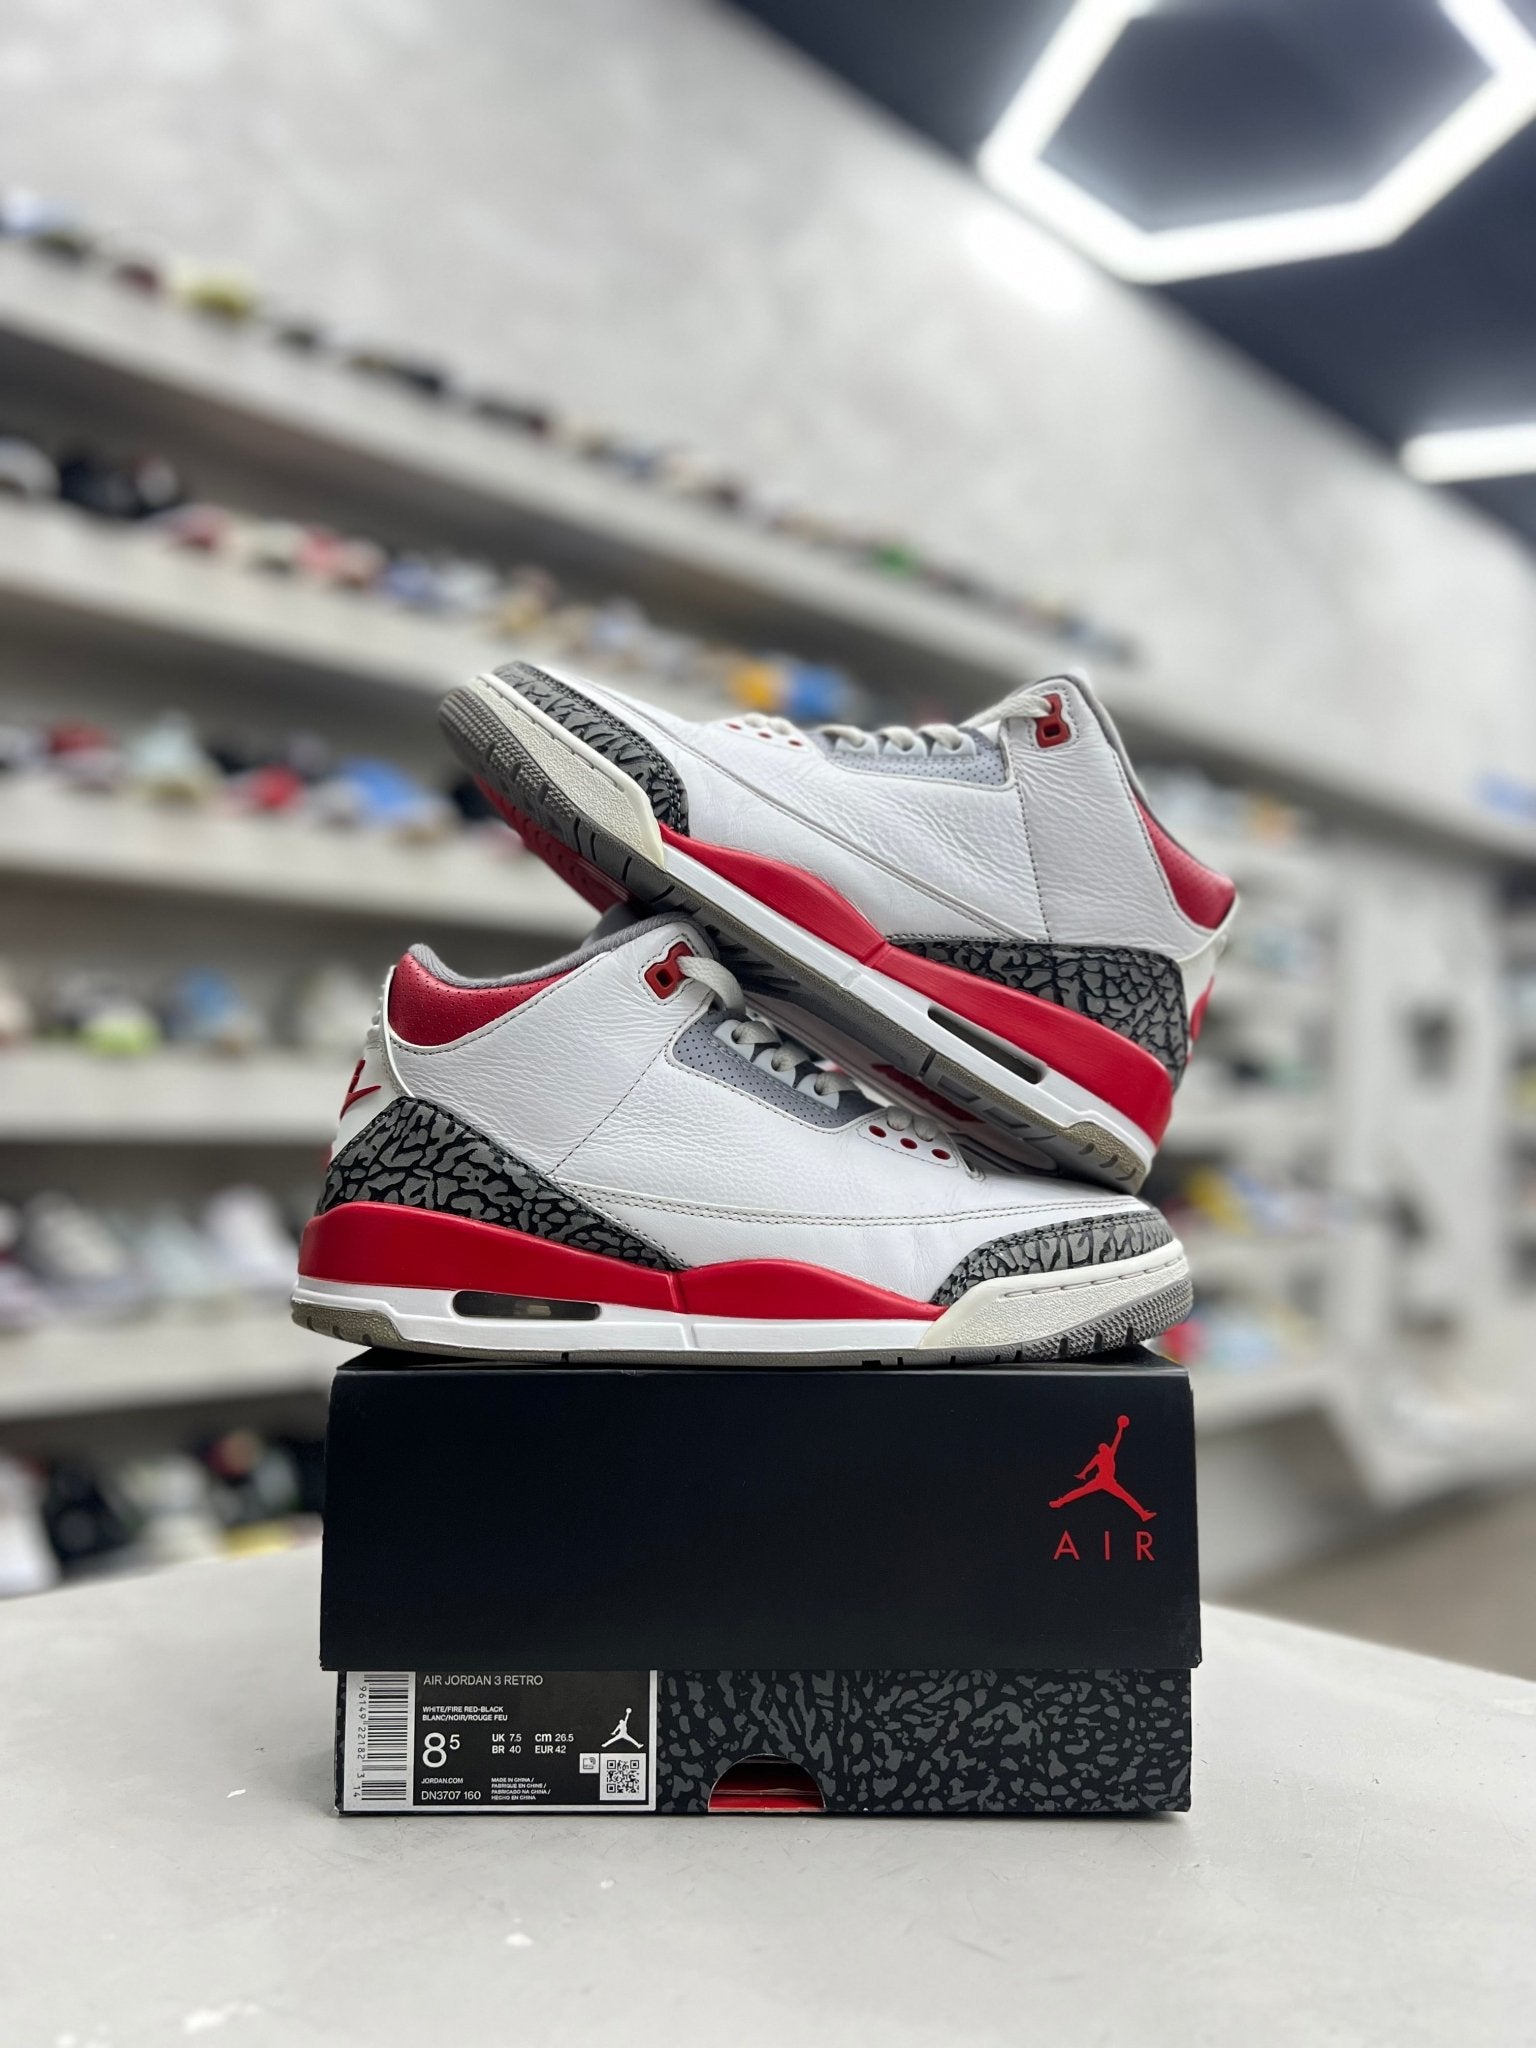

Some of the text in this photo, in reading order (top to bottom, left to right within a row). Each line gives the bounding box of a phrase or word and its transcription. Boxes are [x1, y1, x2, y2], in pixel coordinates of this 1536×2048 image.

[1053, 1530, 1156, 1561] AIR
[423, 1675, 544, 1686] AIR JORDAN 3 RETRO
[491, 1733, 506, 1742] UK
[534, 1734, 552, 1742] cm
[554, 1733, 574, 1742] 26.5
[491, 1745, 567, 1754] BR 40 EUR 42
[421, 1791, 482, 1800] DN3707 160
